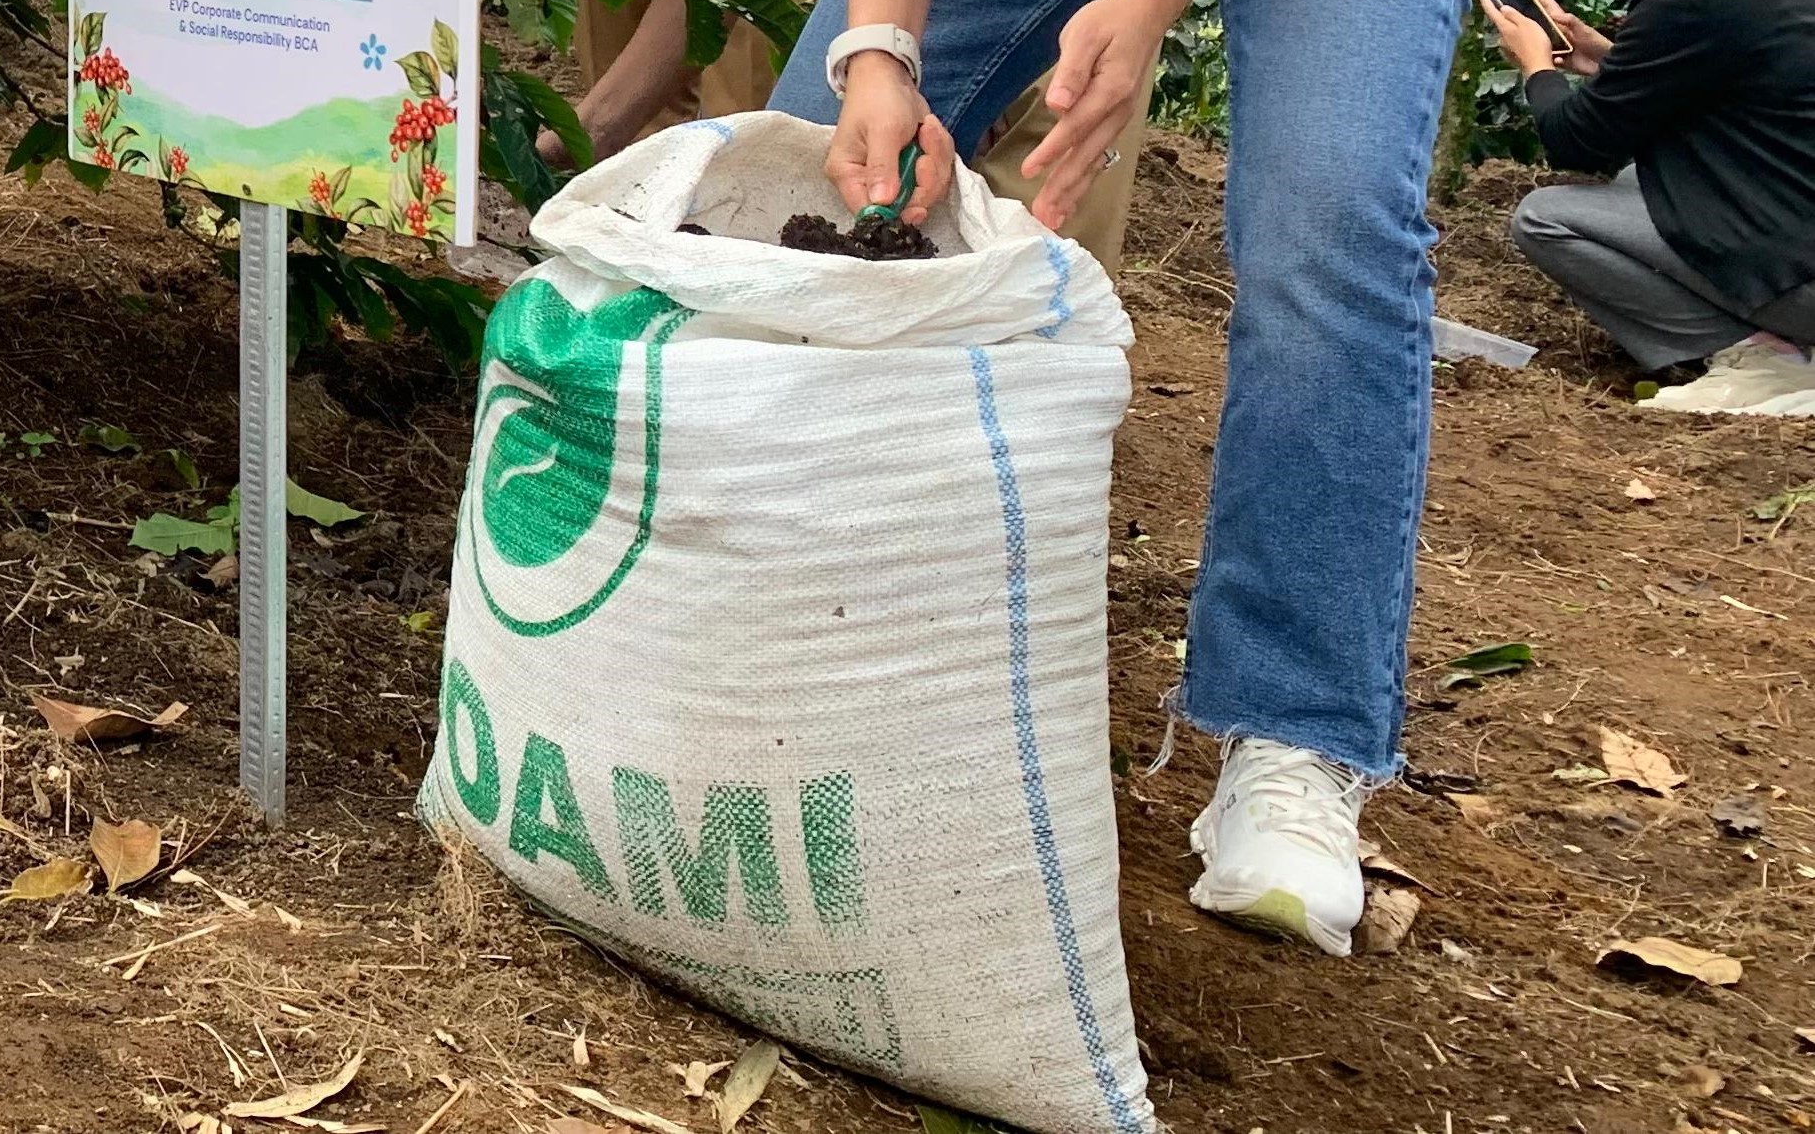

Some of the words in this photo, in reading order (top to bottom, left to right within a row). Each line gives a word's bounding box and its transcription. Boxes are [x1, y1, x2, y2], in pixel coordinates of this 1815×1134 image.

[191, 1, 242, 20] Corporate
[244, 8, 330, 33] Communication
[179, 19, 186, 33] &
[189, 21, 218, 37] Social
[221, 26, 291, 51] Responsibility
[294, 36, 319, 52] BCA
